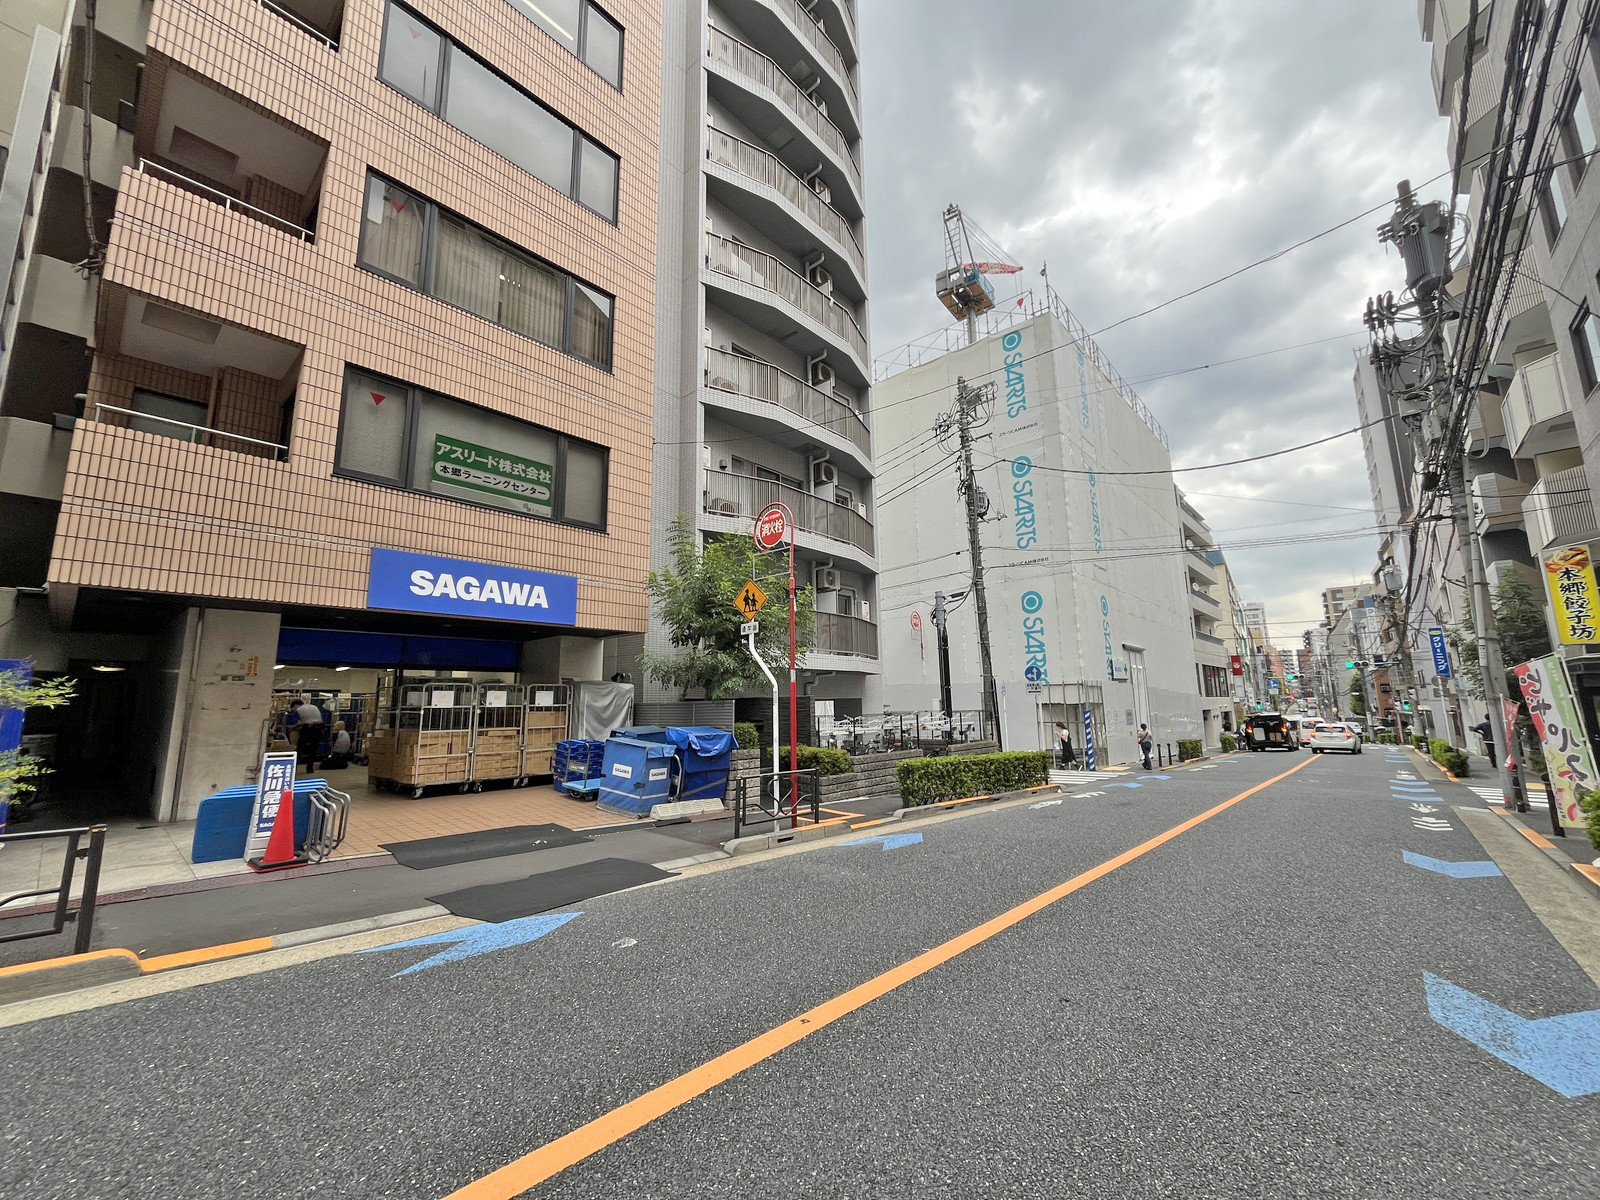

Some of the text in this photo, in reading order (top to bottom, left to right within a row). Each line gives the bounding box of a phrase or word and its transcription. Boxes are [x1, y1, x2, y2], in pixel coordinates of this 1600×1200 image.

[1004, 352, 1027, 419] STARTS
[436, 442, 551, 483] アスリード株式会社
[439, 464, 546, 495] 本郷ラーニングセンター
[761, 519, 784, 538] 消火栓
[1012, 480, 1037, 549] STARTS
[409, 570, 549, 609] SAGAWA
[1558, 566, 1596, 640] 本郷餃子坊
[1432, 636, 1447, 671] クリーニング
[262, 764, 285, 818] 佐川急便
